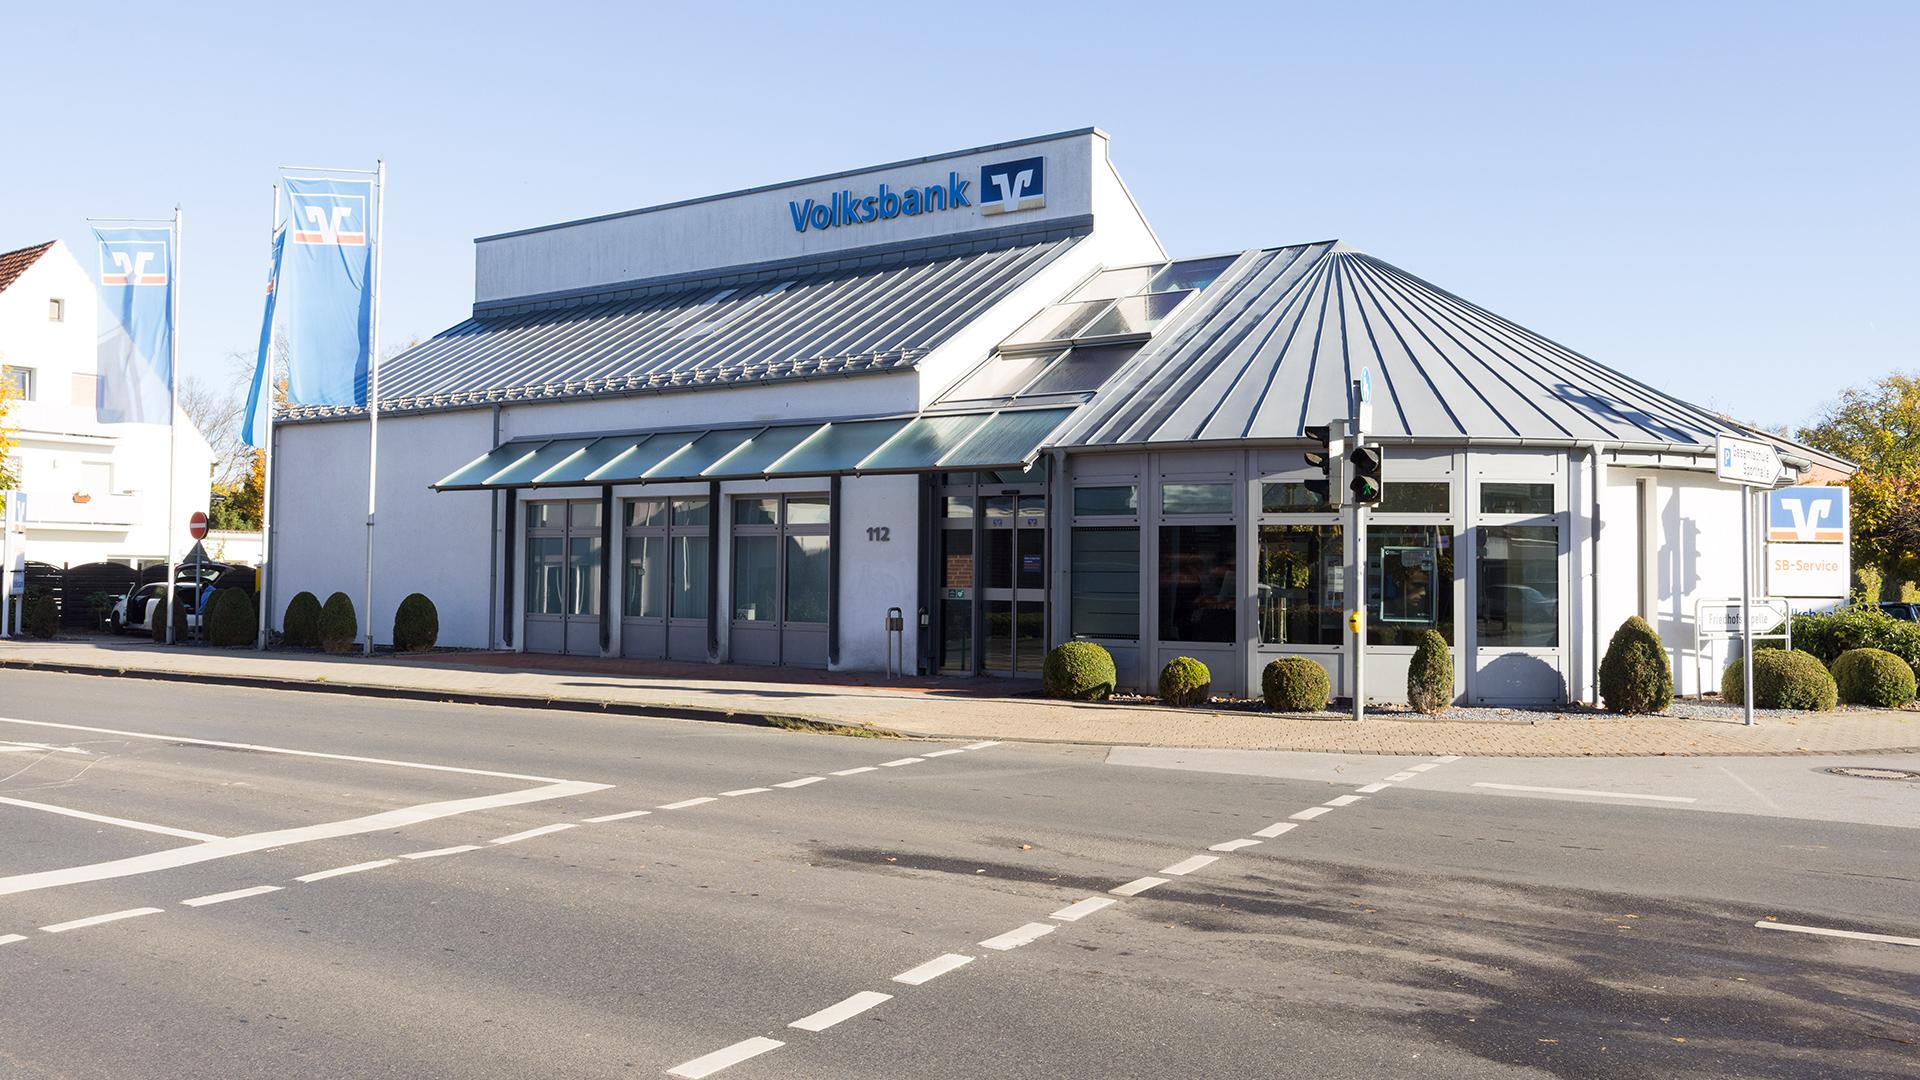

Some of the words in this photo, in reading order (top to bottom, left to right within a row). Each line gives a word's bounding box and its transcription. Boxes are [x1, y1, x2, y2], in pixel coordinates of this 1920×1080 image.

[789, 171, 971, 232] Volksbank
[866, 526, 890, 542] 112
[1775, 559, 1839, 572] SB-Service
[1708, 613, 1768, 627] Friedhofspelle
